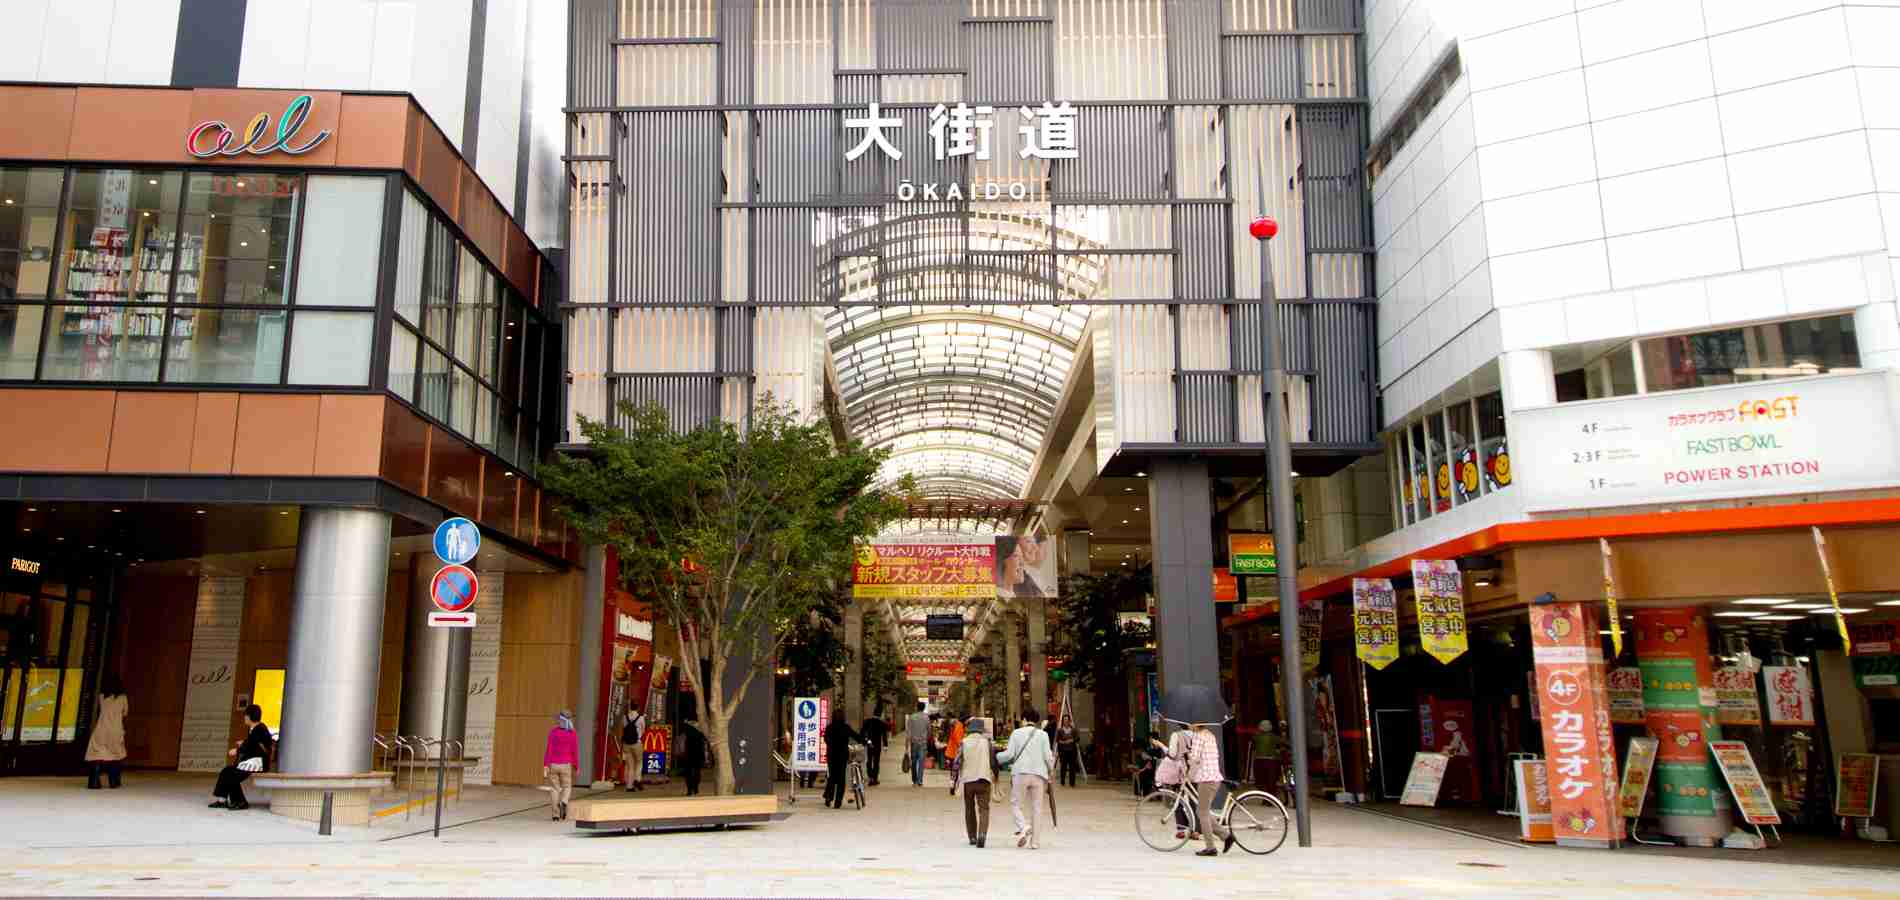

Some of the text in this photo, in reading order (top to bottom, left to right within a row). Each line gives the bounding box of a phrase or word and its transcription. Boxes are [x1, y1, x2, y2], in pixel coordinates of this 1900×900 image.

[845, 101, 1079, 161] 大街道
[898, 180, 1027, 201] ŌKAIDO
[1664, 460, 1820, 484] POWER STATION
[11, 557, 41, 574] PARIGOT
[856, 566, 993, 584] 新規スタッフ大募集
[1552, 710, 1592, 799] カラオケ
